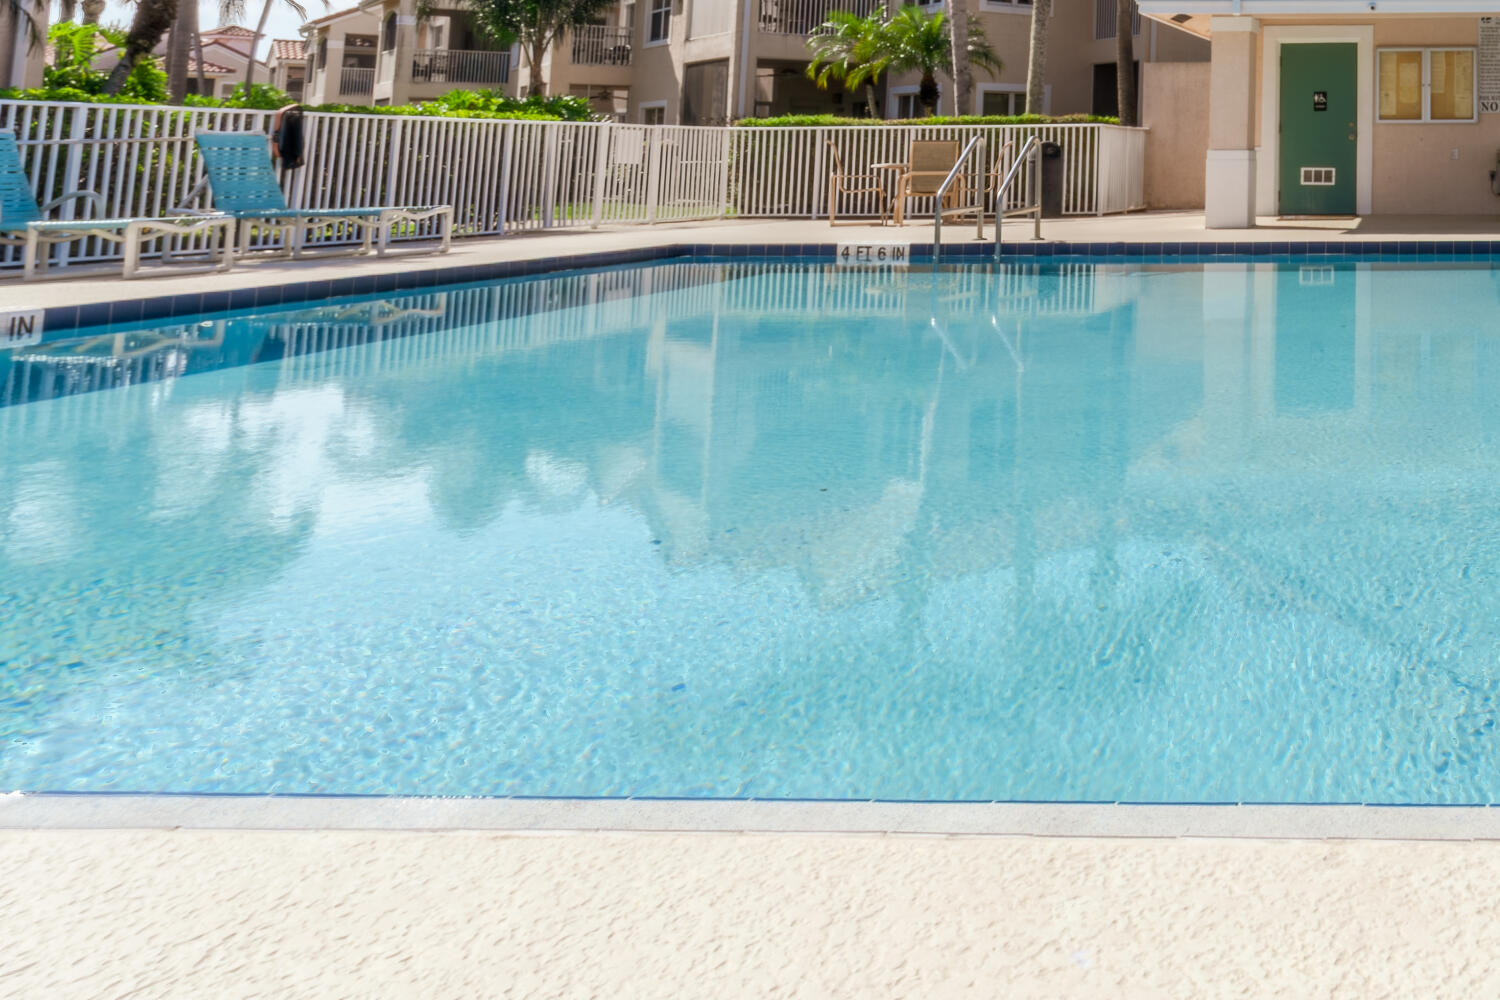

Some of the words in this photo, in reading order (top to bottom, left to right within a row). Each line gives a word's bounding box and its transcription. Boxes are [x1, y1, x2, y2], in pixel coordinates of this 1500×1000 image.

[1480, 101, 1498, 112] NO
[841, 246, 850, 261] 4
[877, 246, 887, 260] 6
[892, 246, 905, 260] IN
[9, 314, 35, 340] IN
